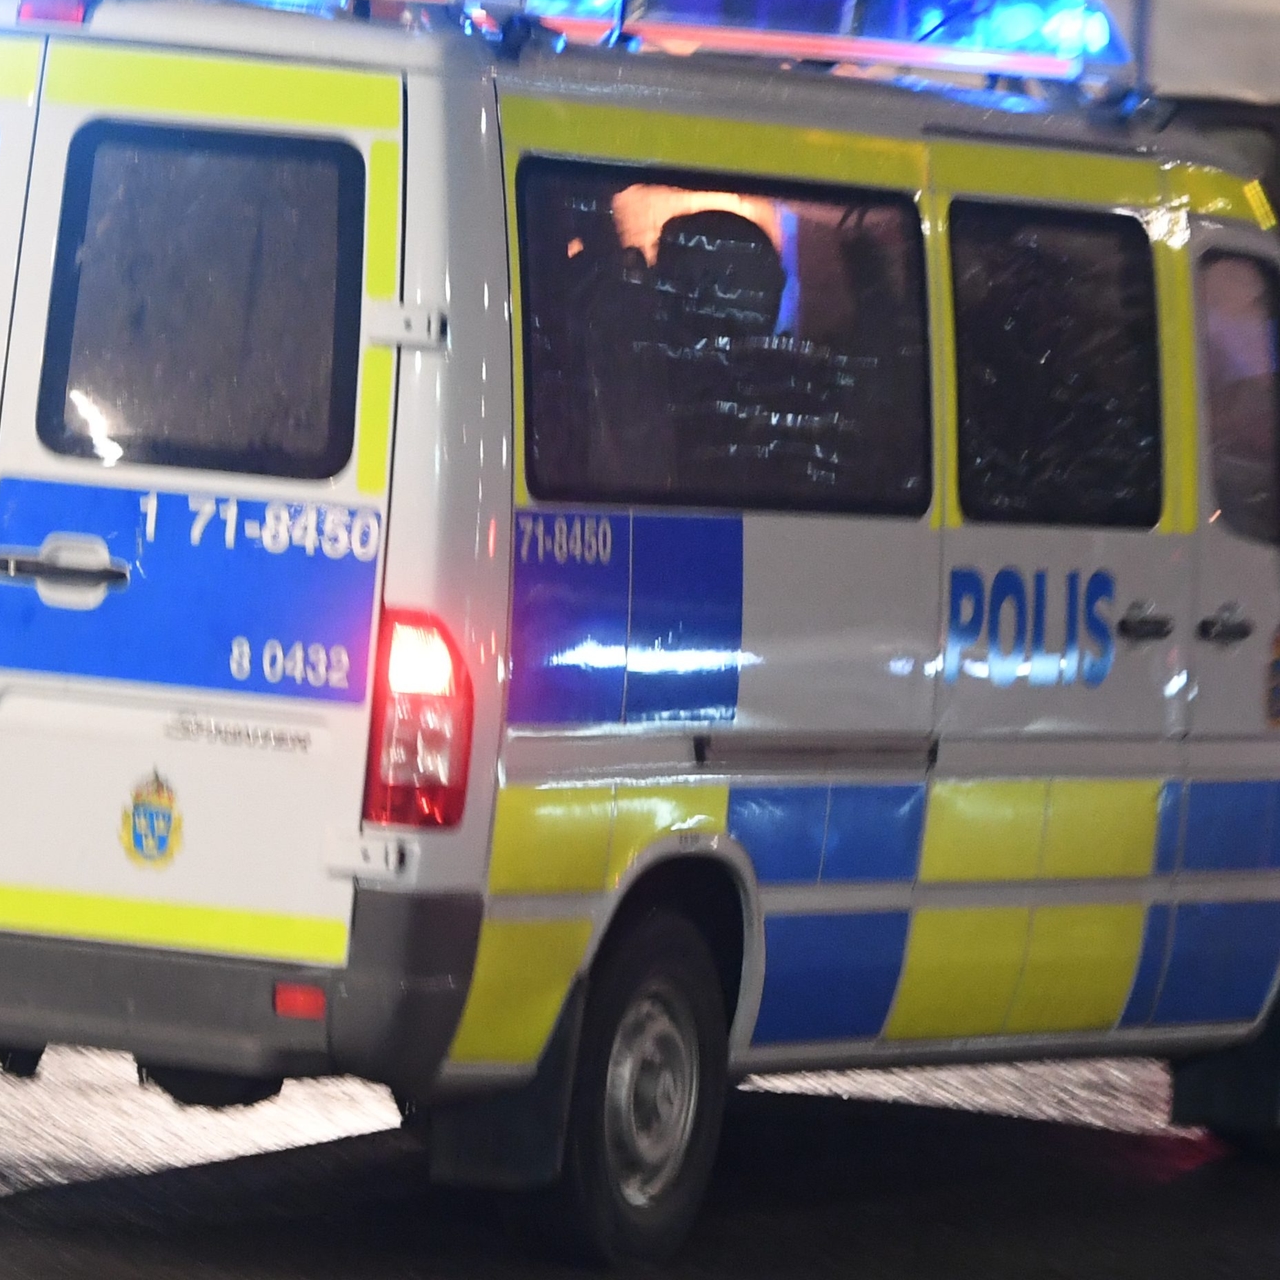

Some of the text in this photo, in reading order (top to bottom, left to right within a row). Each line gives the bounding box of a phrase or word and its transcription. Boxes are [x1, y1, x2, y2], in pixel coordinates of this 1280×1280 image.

[140, 492, 380, 562] 1 71-8450
[518, 516, 613, 564] 71-8450
[944, 566, 1116, 689] POLIS
[262, 639, 350, 689] 0432
